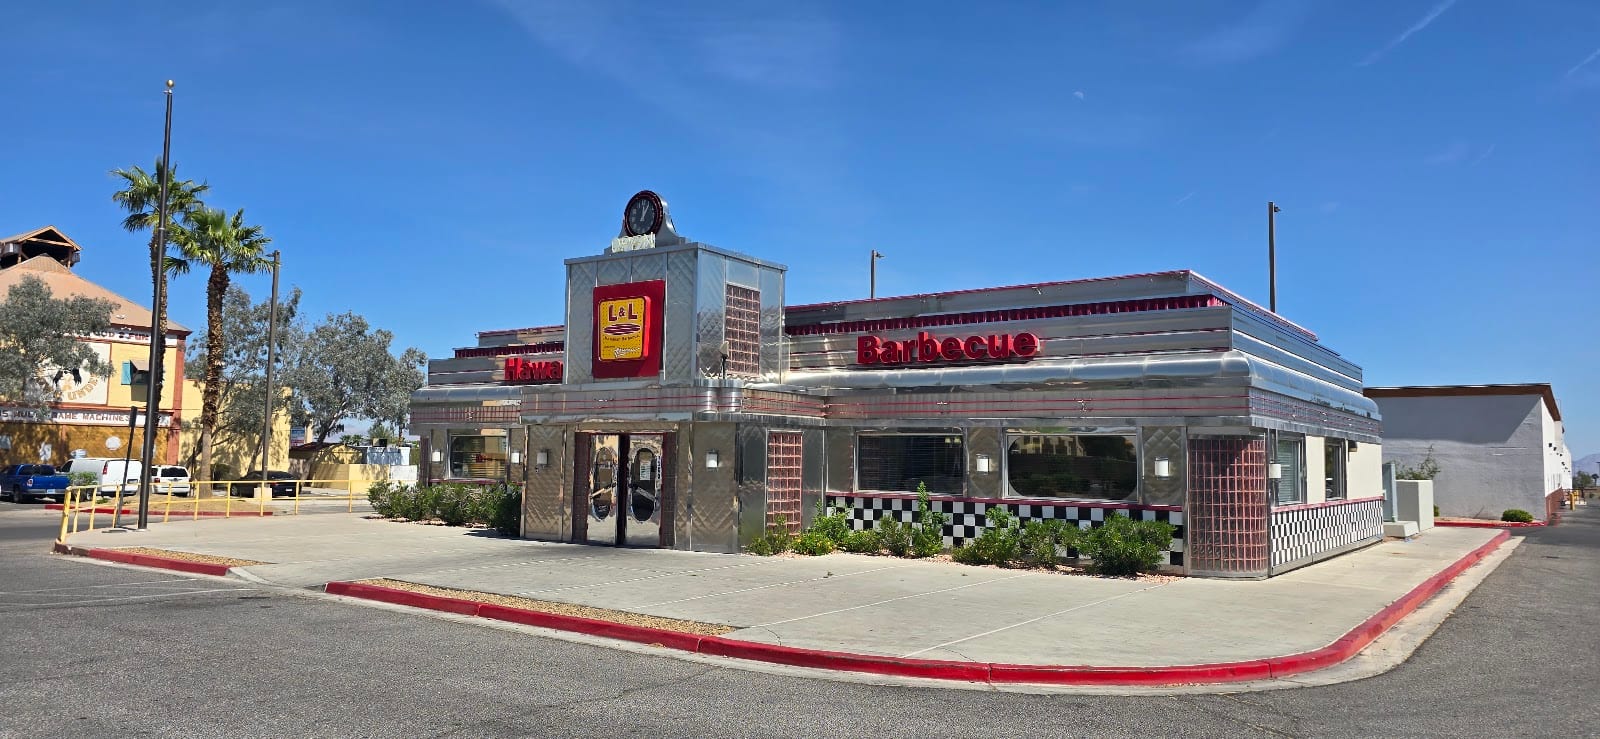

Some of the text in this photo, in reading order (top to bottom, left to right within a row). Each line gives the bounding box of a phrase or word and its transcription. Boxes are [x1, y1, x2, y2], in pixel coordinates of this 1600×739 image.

[857, 331, 1041, 364] Barbecue
[504, 357, 564, 381] Hawa
[82, 412, 131, 423] MACHINES
